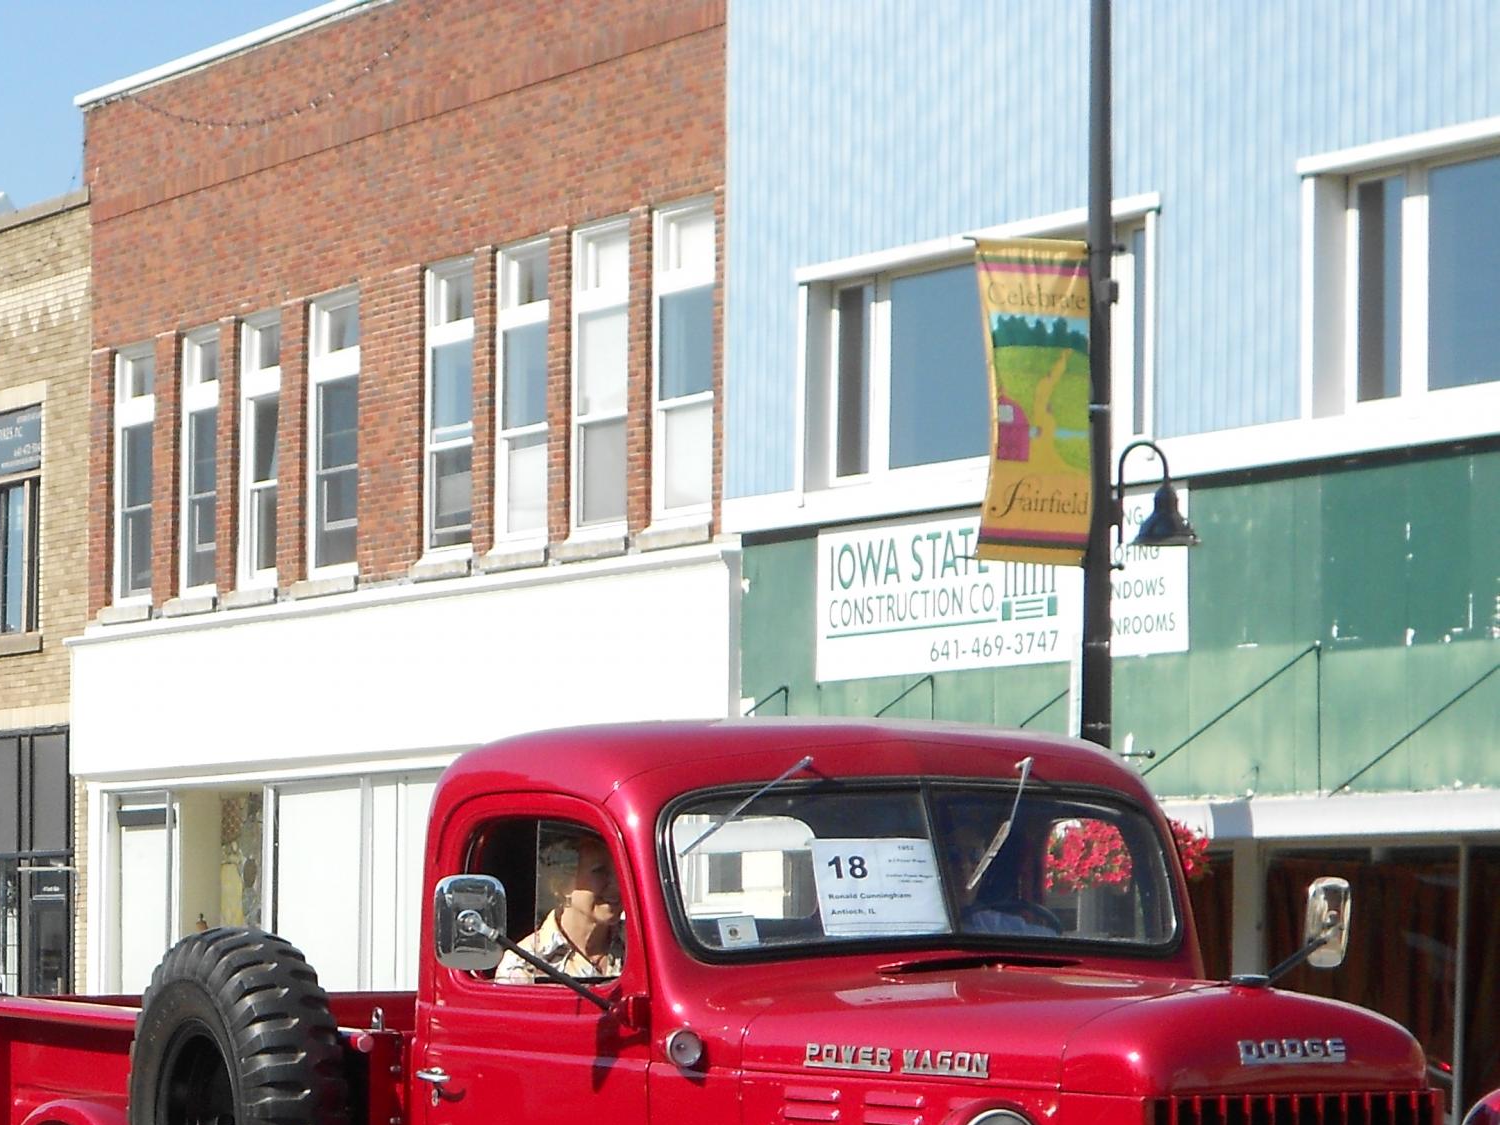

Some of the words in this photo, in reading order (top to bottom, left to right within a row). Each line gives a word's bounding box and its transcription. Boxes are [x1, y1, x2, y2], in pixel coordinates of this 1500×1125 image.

[989, 282, 1086, 310] Celebrate
[991, 477, 1088, 518] Fairfield
[830, 537, 900, 591] IOWA
[1111, 577, 1166, 600] NDOWS
[829, 584, 964, 629] CONSTRUCTION
[969, 582, 1000, 614] CO.
[1111, 612, 1176, 636] NROOMS
[930, 630, 1060, 662] 641-469-3747
[828, 855, 868, 880] 18
[859, 892, 912, 900] Cunningham
[804, 1042, 891, 1073] POWER
[901, 1049, 989, 1079] WAGON
[1236, 1037, 1348, 1065] DODGE
